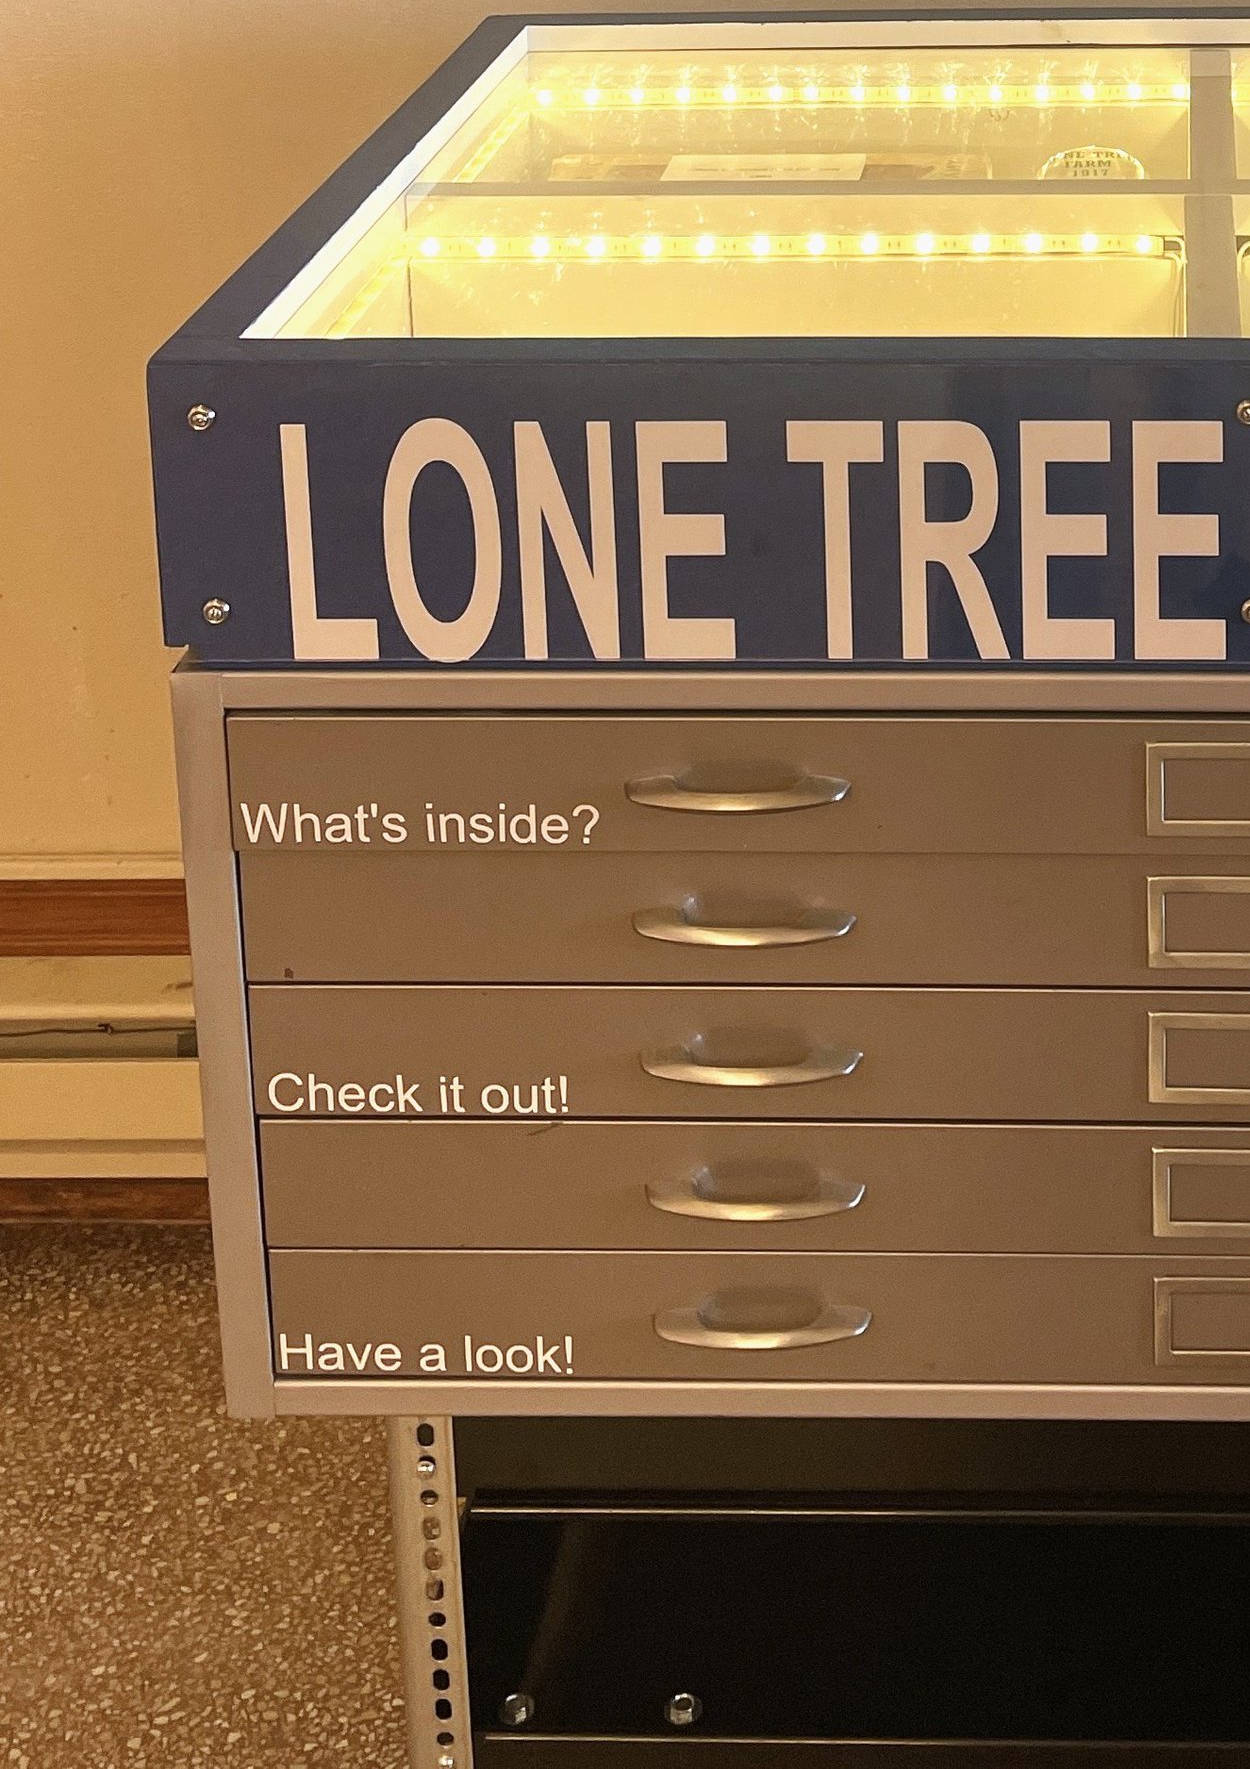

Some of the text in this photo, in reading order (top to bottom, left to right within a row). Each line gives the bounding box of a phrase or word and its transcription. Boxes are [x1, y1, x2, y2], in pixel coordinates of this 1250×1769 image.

[280, 418, 736, 662] LONE
[786, 421, 1226, 662] TREE
[241, 803, 599, 843] What's inside?
[269, 1073, 568, 1113] Check it out!
[280, 1334, 573, 1374] Have a look!
